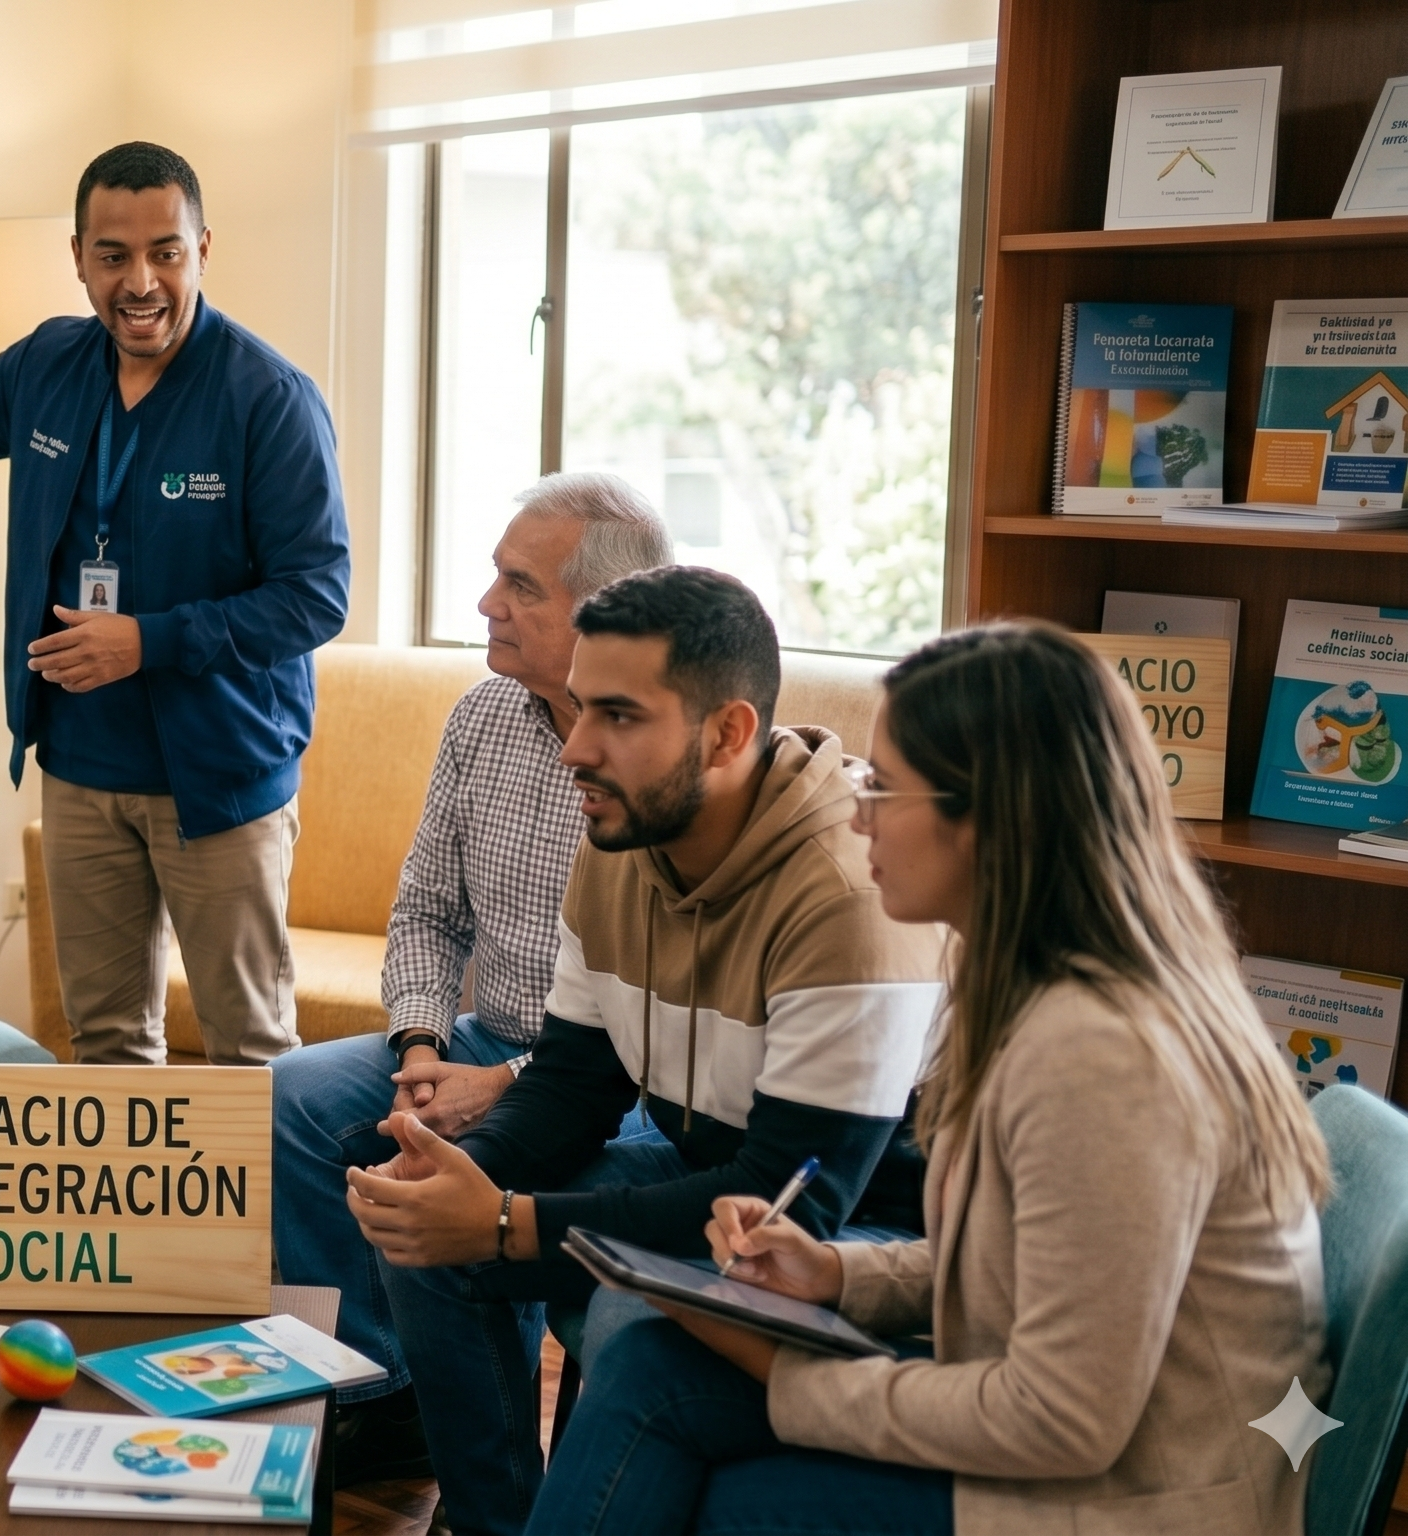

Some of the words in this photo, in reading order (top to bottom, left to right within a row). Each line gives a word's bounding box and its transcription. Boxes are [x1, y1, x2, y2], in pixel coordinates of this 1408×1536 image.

[189, 473, 219, 482] SALUD
[1118, 657, 1196, 693] ACIO
[127, 1098, 190, 1148] DE
